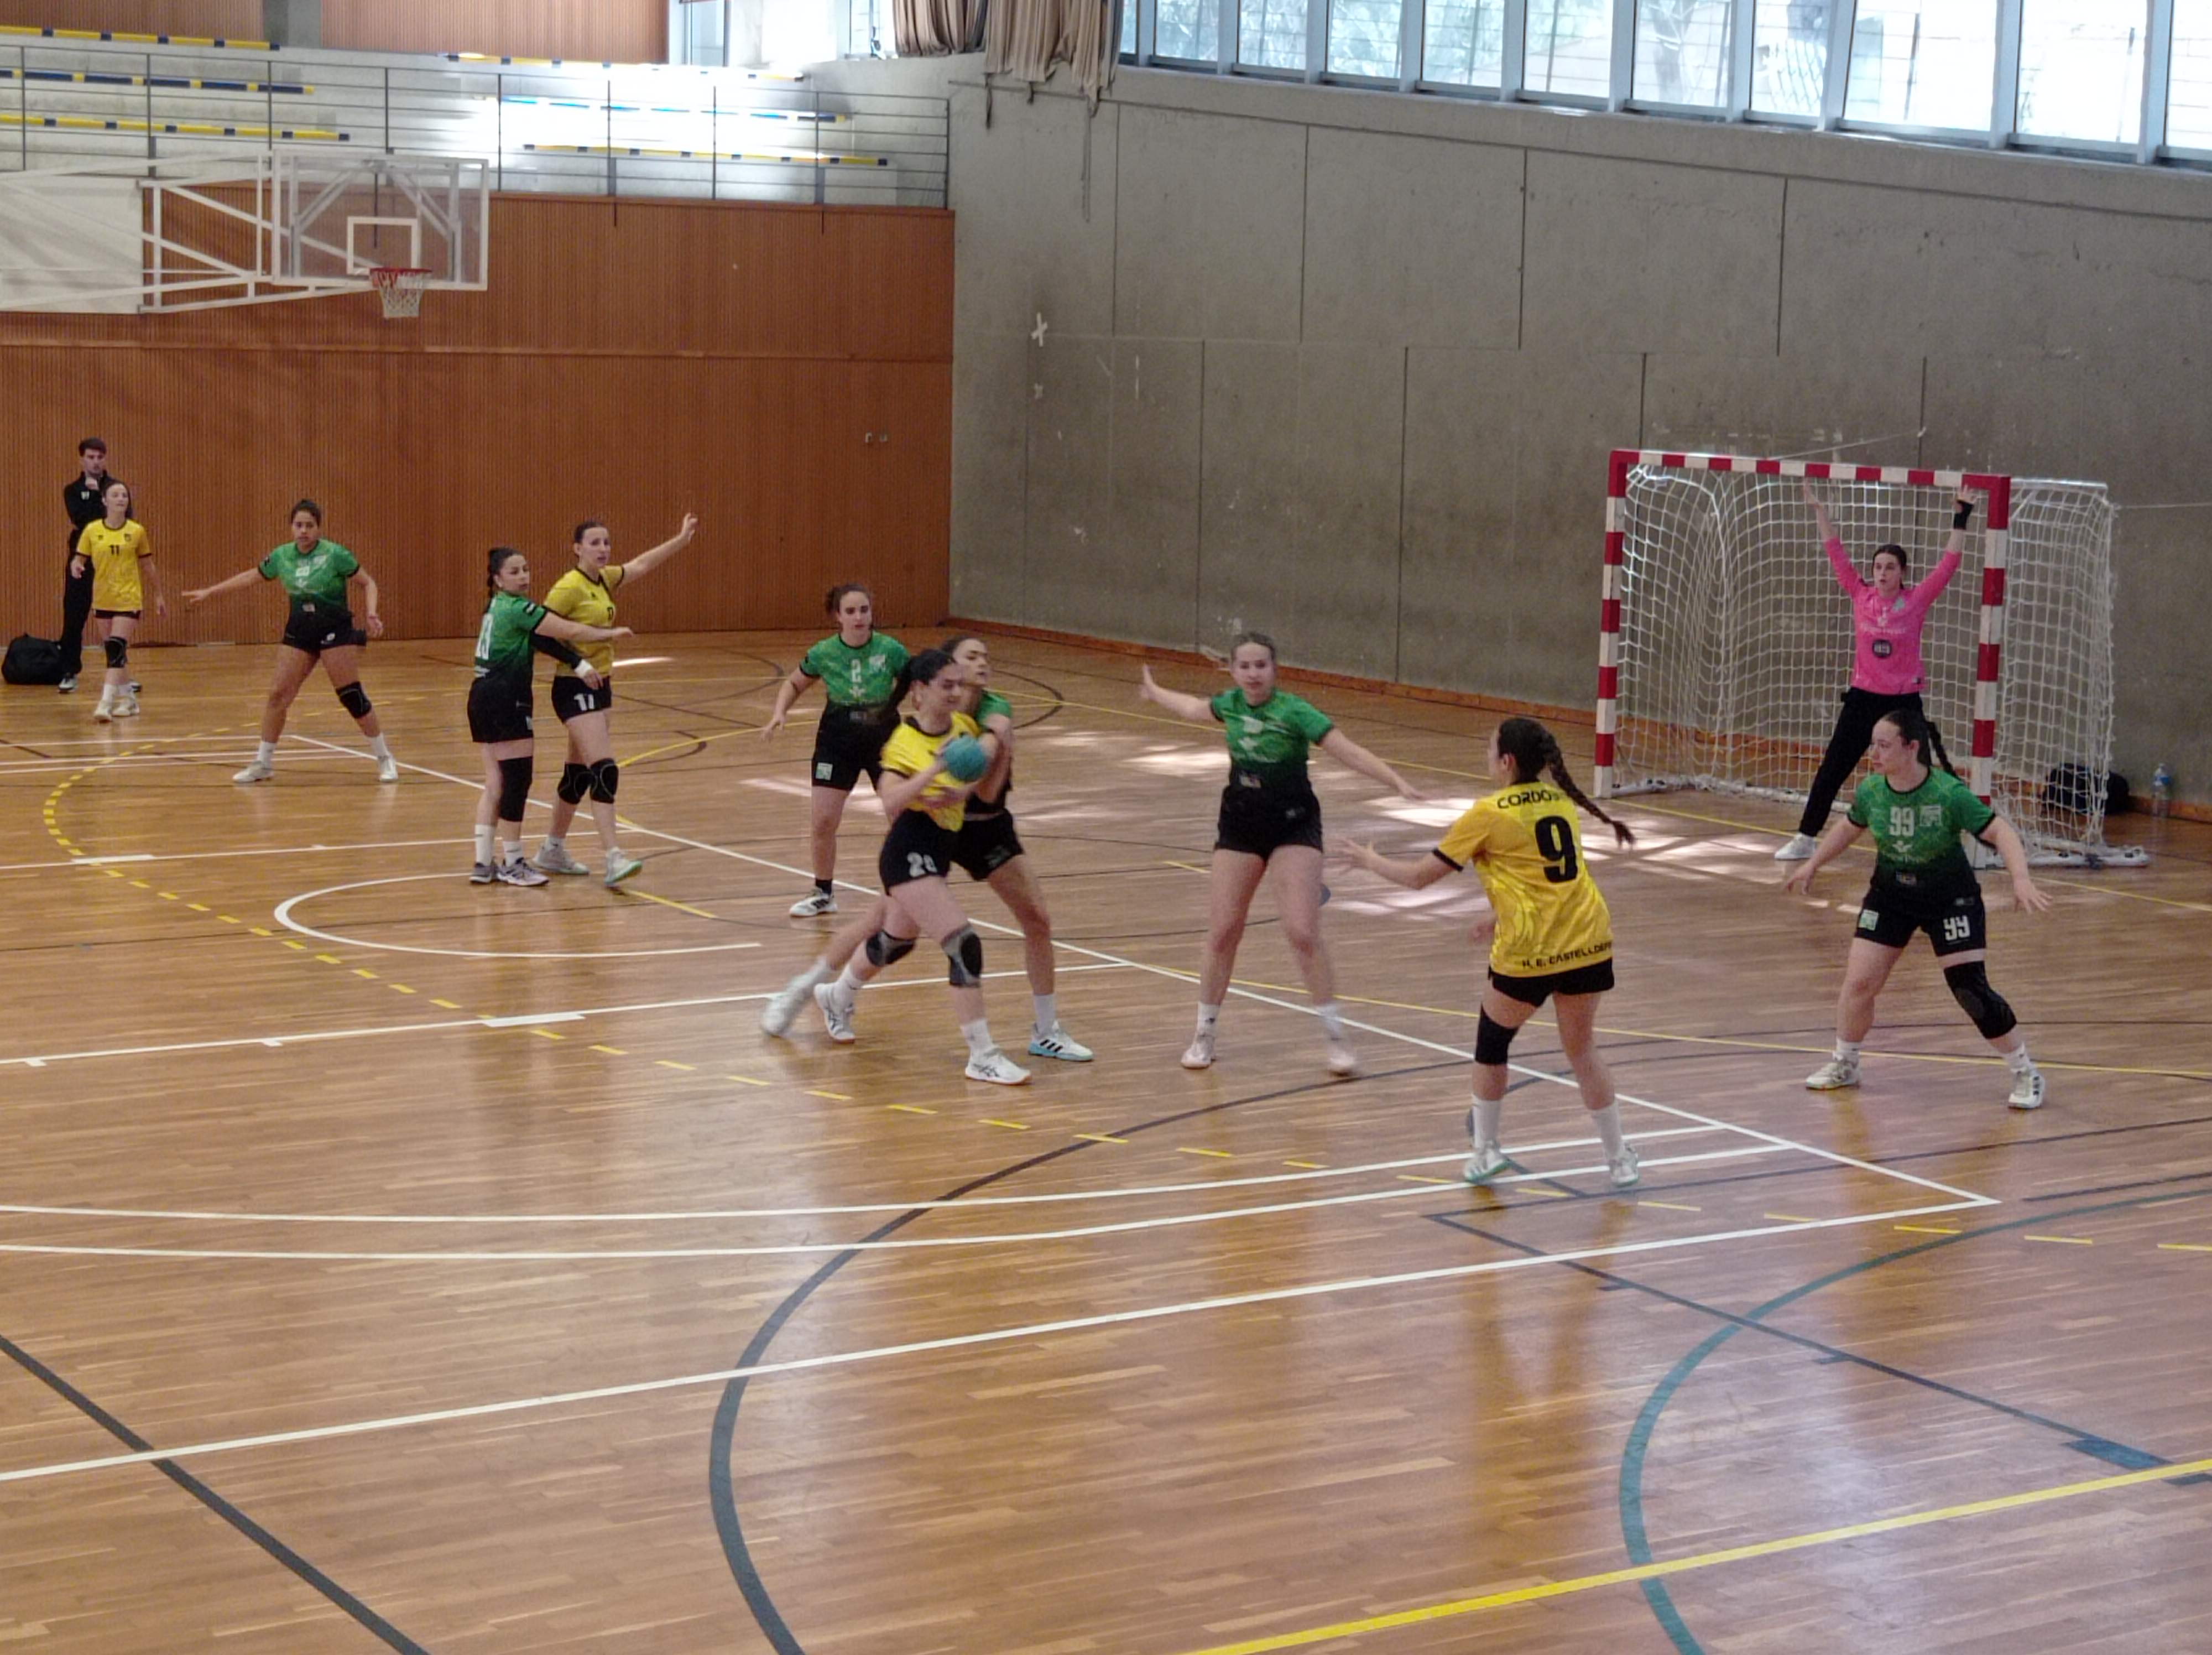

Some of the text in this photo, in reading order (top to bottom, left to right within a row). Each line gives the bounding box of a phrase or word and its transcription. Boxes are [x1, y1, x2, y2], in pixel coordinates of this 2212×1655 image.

[109, 544, 119, 556] 11
[1889, 806, 1915, 836] 99
[1535, 815, 1578, 883] 9
[1943, 914, 1970, 940] 99
